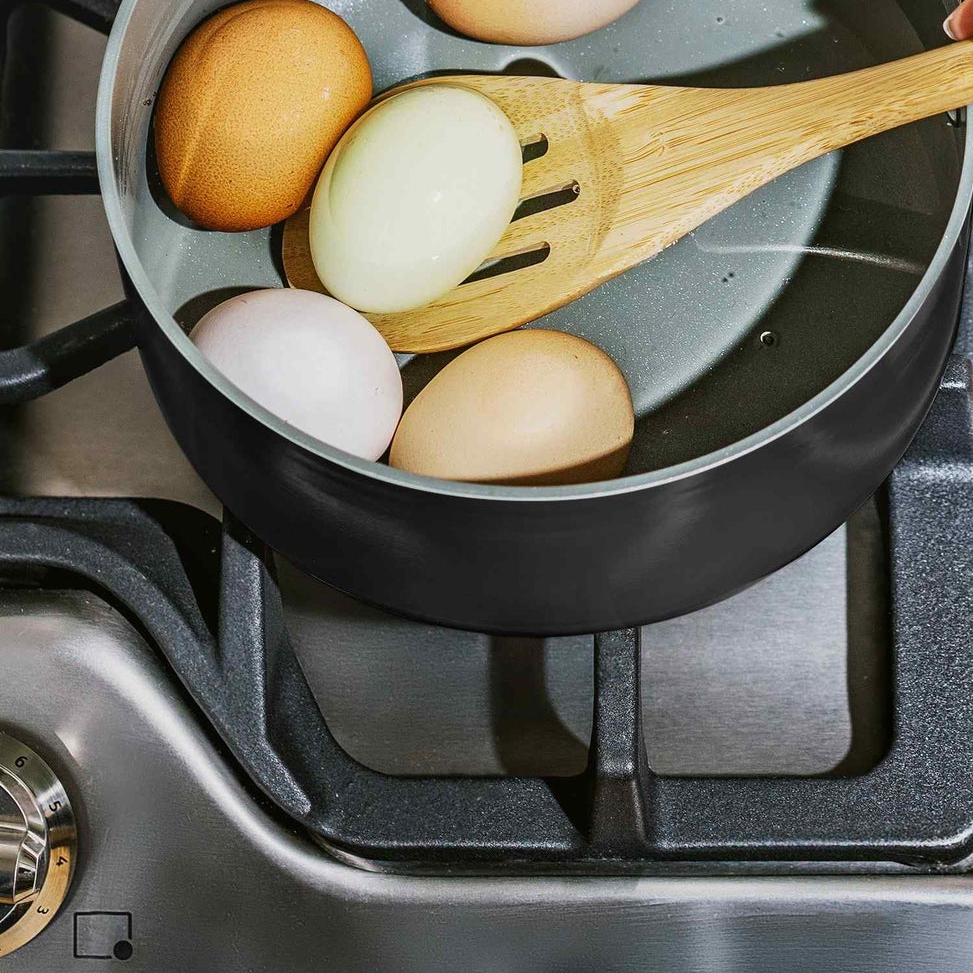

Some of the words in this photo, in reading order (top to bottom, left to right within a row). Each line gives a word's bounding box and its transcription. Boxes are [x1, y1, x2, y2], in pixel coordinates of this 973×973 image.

[15, 756, 28, 768] 6
[49, 801, 61, 812] 5
[56, 856, 68, 867] 4
[37, 906, 49, 915] 3
